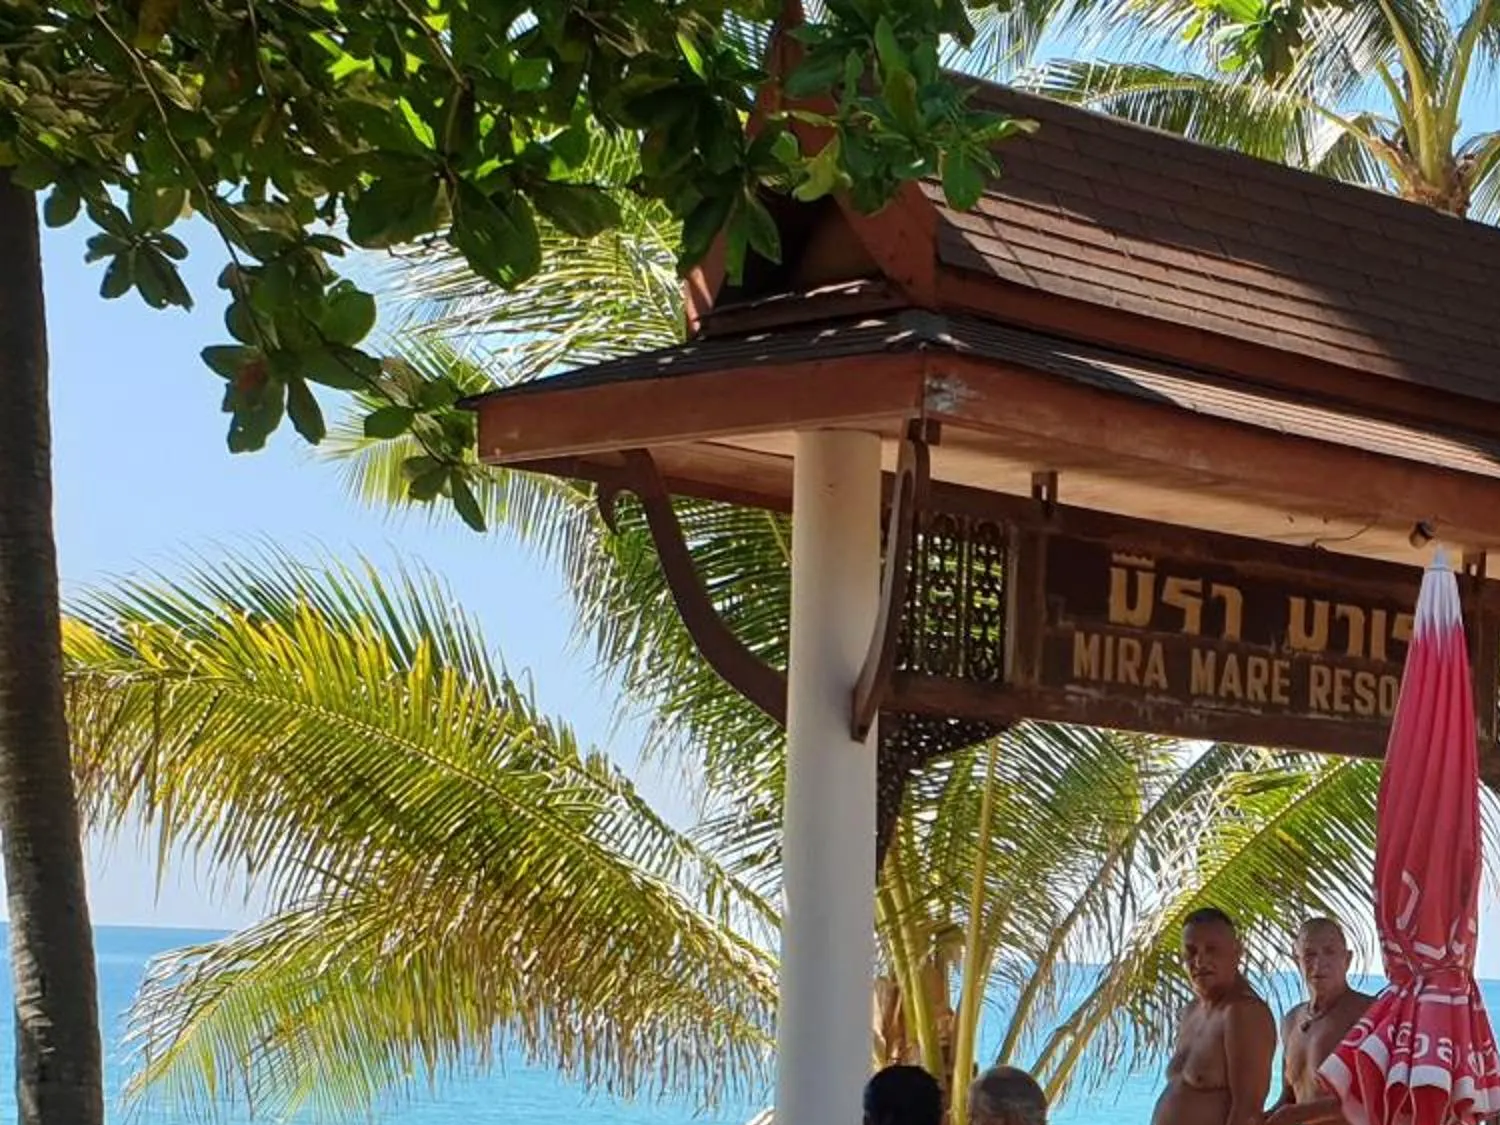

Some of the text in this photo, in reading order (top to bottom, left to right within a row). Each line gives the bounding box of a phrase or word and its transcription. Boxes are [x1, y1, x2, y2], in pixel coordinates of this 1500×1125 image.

[1073, 631, 1400, 717] MIRA MARE RESO
